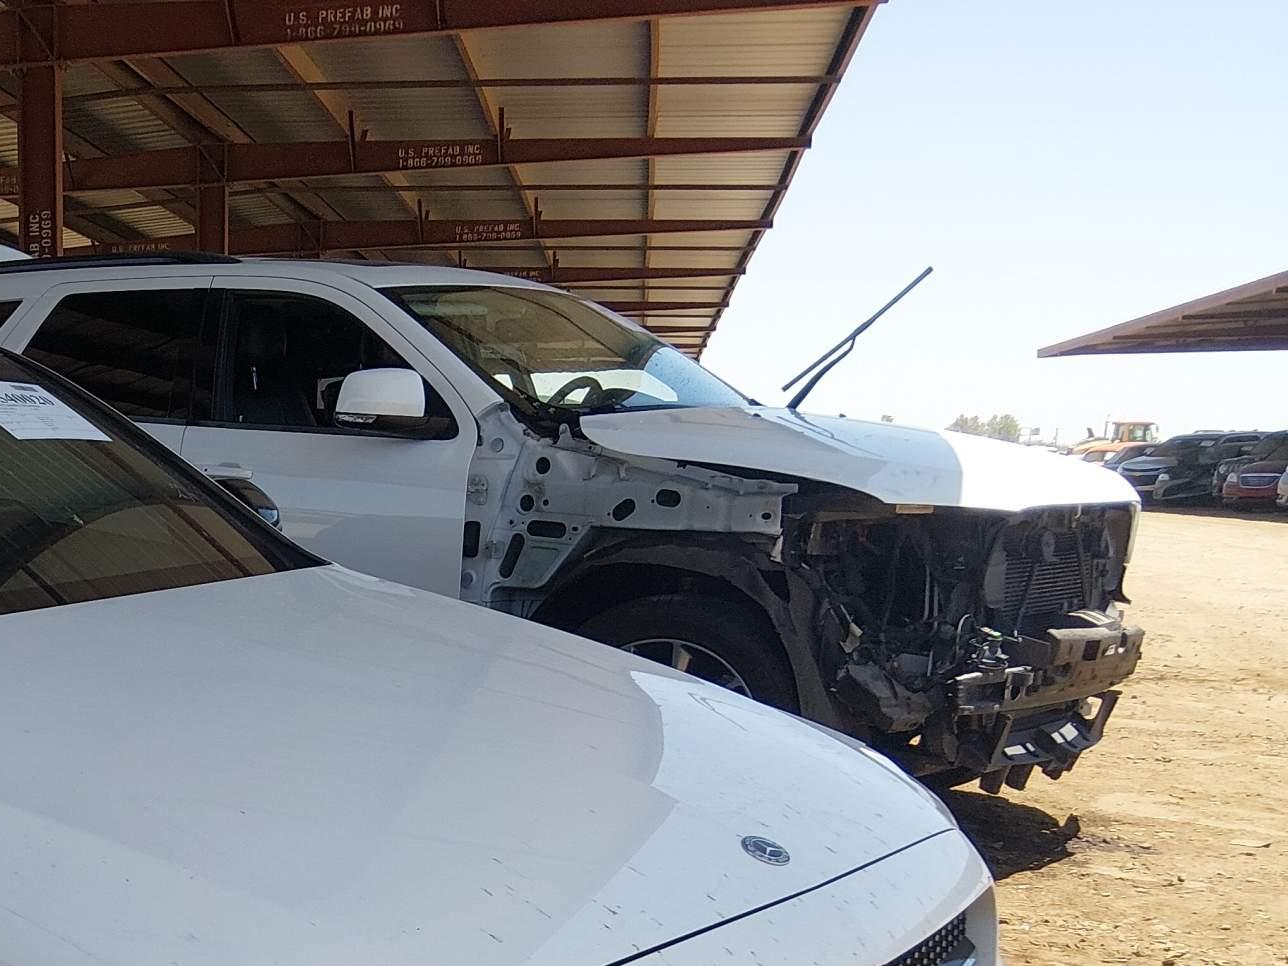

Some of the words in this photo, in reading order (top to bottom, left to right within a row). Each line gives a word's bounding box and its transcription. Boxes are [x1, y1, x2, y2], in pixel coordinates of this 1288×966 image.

[285, 11, 311, 25] U.S.
[318, 6, 372, 23] PREFAB
[398, 147, 417, 158] U.S.
[422, 145, 460, 156] PREFAB
